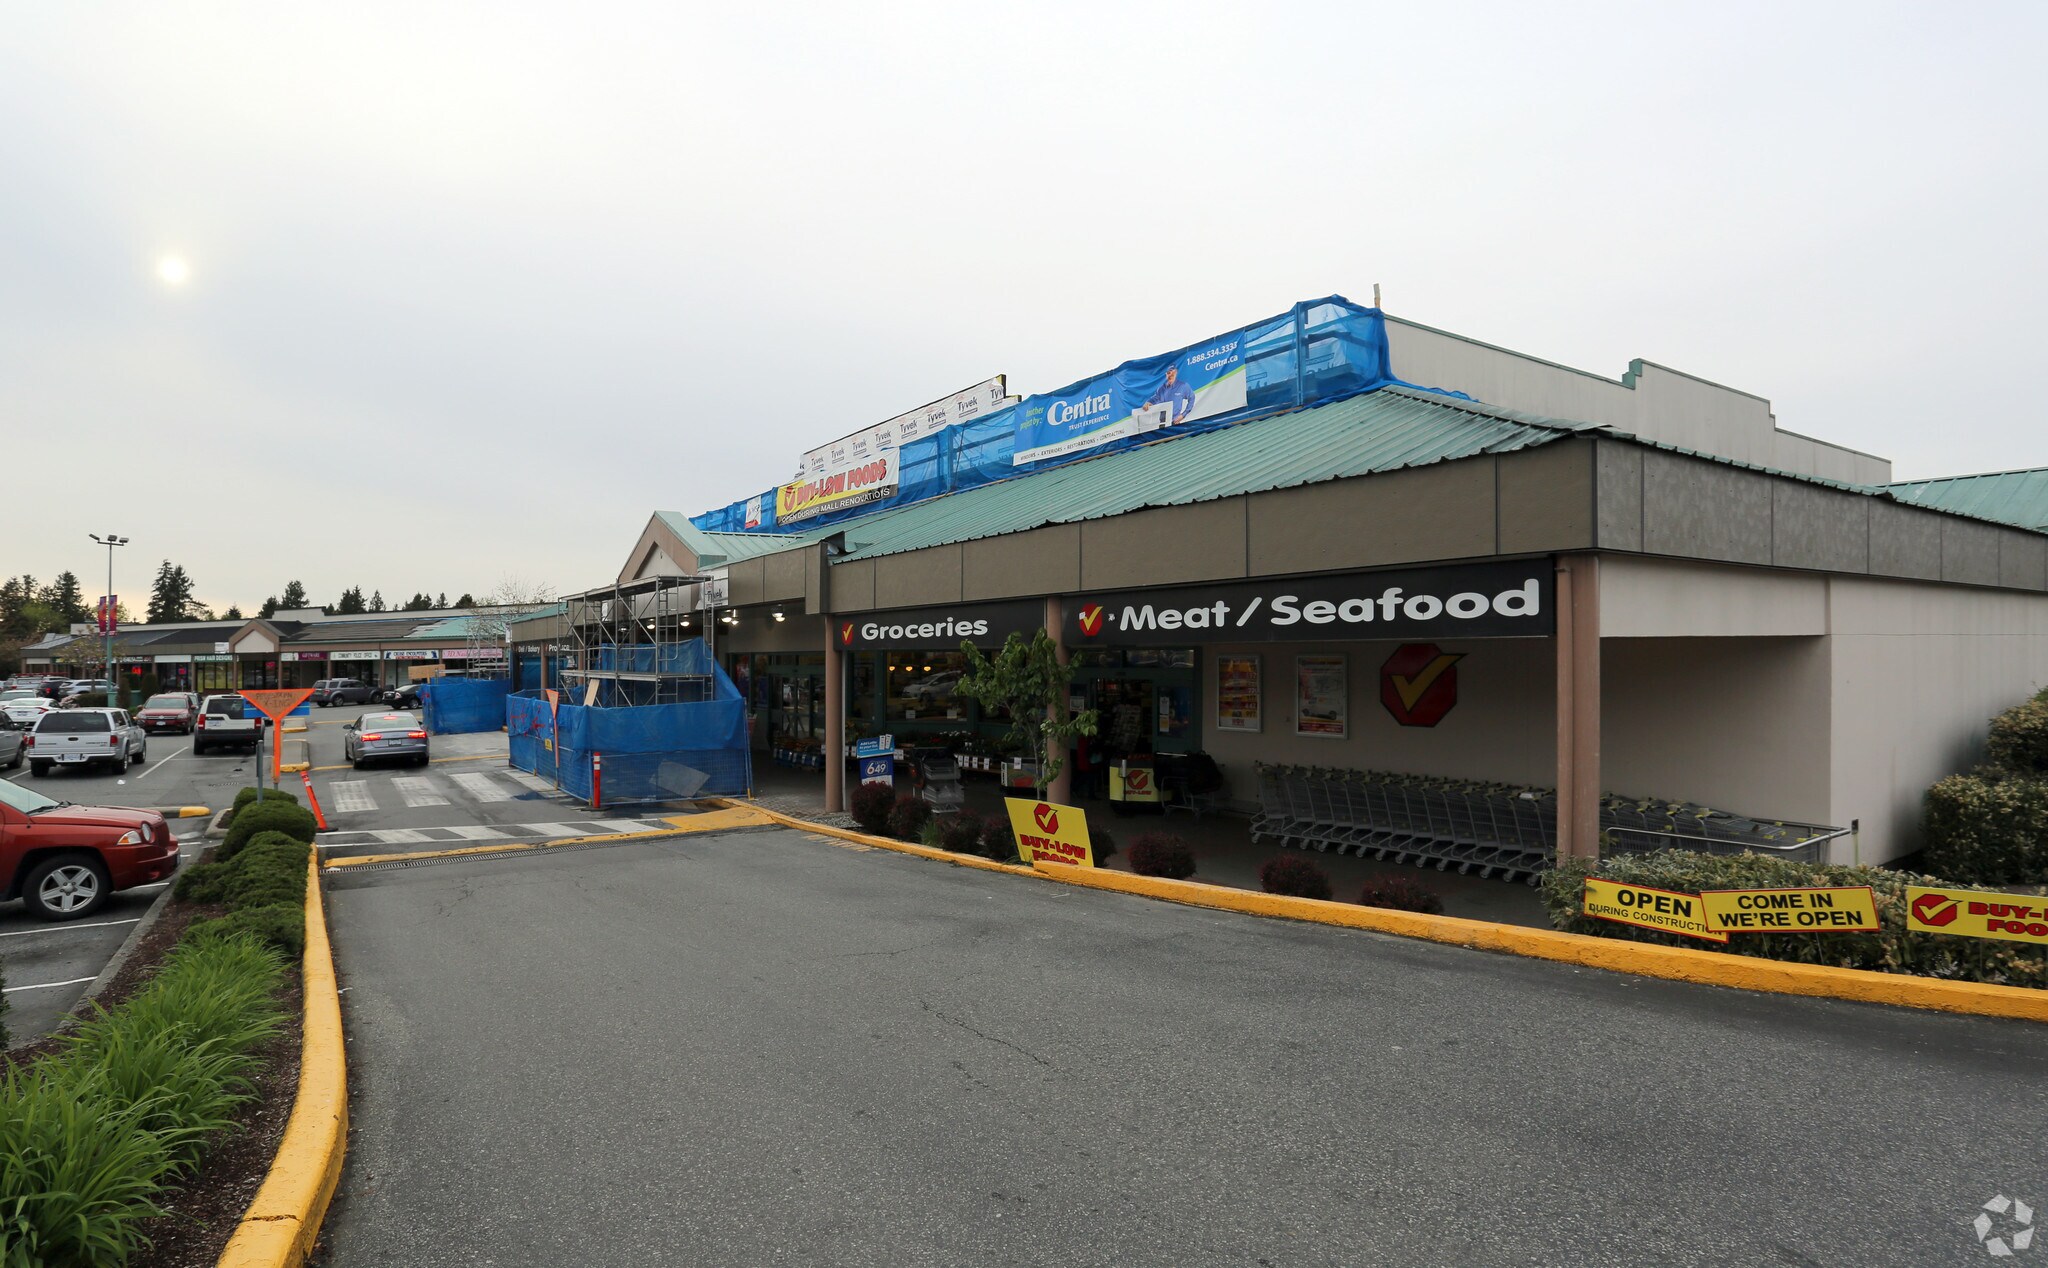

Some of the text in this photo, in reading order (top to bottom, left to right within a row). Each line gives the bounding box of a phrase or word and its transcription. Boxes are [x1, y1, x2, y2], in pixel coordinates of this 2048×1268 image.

[1205, 355, 1238, 370] Centra.ca
[958, 396, 978, 411] Tyvek
[1047, 392, 1111, 426] Centra
[928, 409, 946, 423] Tyvek
[1069, 414, 1110, 430] TRUST EXPERIENCE
[900, 420, 917, 433] Tyvek
[875, 429, 891, 442] Tyvek
[831, 447, 844, 459] Tyvek
[853, 439, 867, 450] Tyvek
[1041, 447, 1062, 456] EXTERIORS
[1067, 438, 1095, 450] RESTORATIONS
[811, 455, 824, 466] Tyvek
[847, 459, 886, 490] FOODS
[798, 506, 819, 519] DURING
[820, 502, 838, 513] MALL
[1120, 600, 1230, 631] Meat
[1270, 578, 1540, 626] Seafood
[861, 617, 988, 640] Groceries
[1020, 834, 1085, 860] BUY-LOW
[1617, 890, 1692, 917] OPEN
[1738, 893, 1833, 910] COME IN
[1589, 903, 1722, 936] DURING CONSTRUCTI
[1718, 911, 1864, 927] WE'RE OPEN
[1987, 919, 2048, 936] FOO
